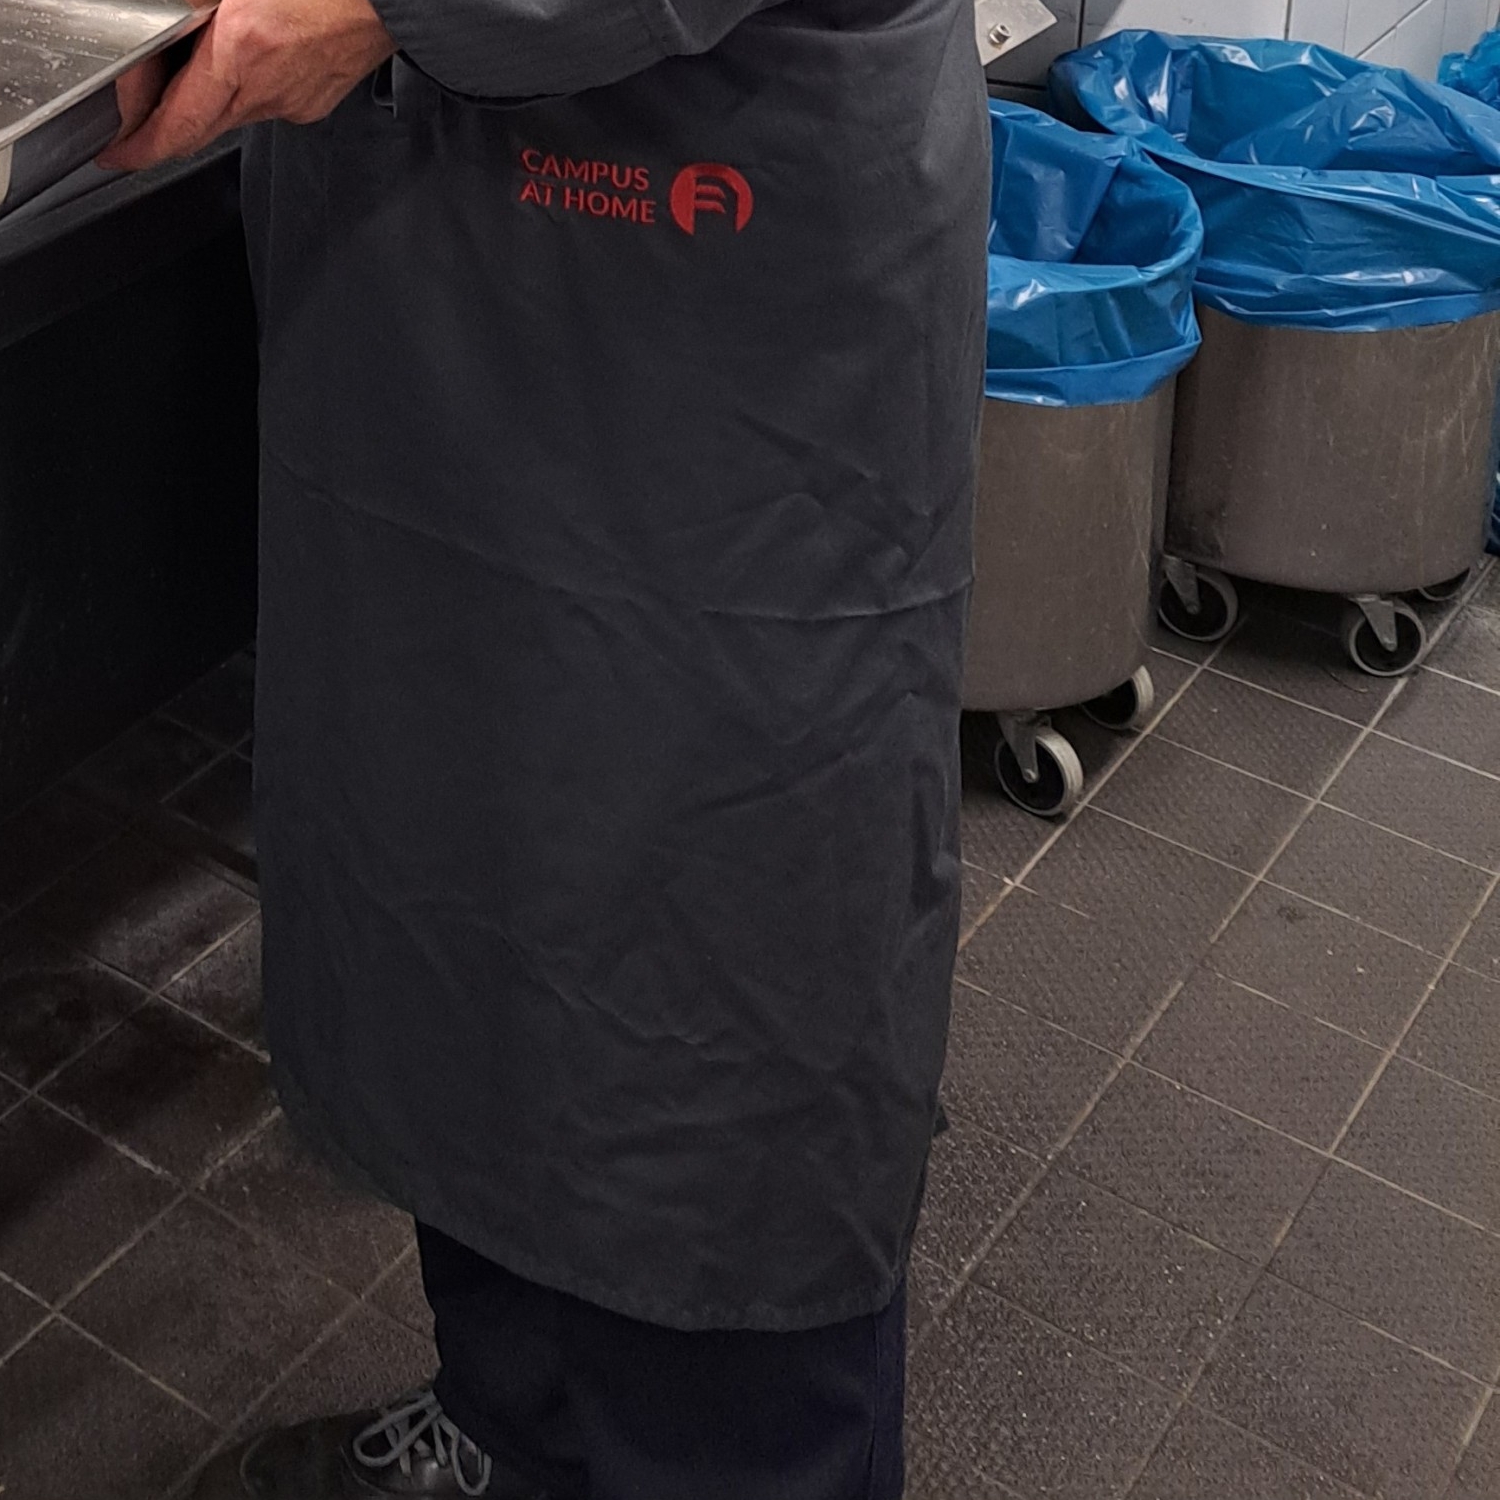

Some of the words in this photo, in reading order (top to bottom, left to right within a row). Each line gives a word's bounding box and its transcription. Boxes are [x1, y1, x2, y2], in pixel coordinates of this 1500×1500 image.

[521, 148, 650, 191] CAMPUS
[519, 179, 556, 207] AT
[562, 186, 657, 223] HOME
